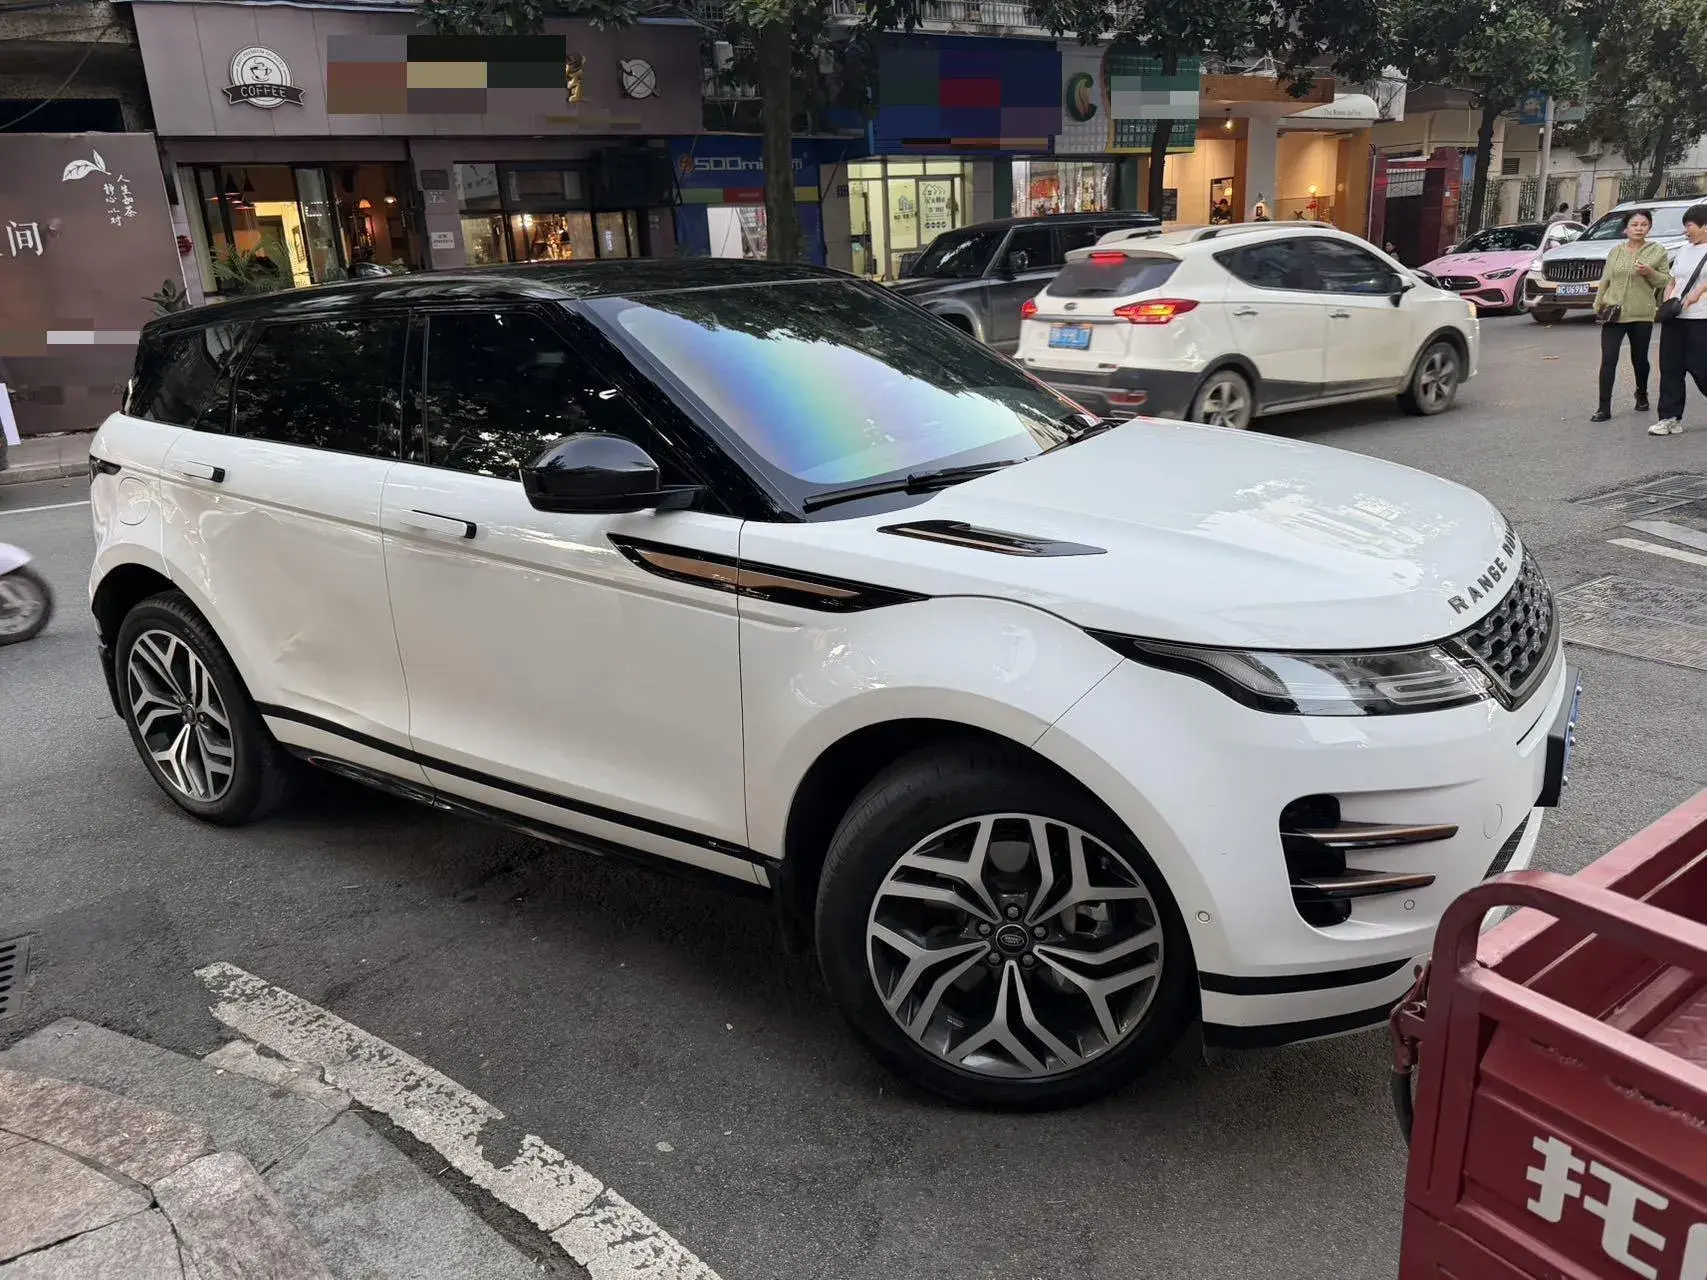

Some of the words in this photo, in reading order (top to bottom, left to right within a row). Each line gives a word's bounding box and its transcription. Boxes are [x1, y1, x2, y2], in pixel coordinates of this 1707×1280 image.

[240, 84, 288, 99] COFFEE
[0, 219, 44, 258] 间
[1447, 556, 1508, 615] RANGE
